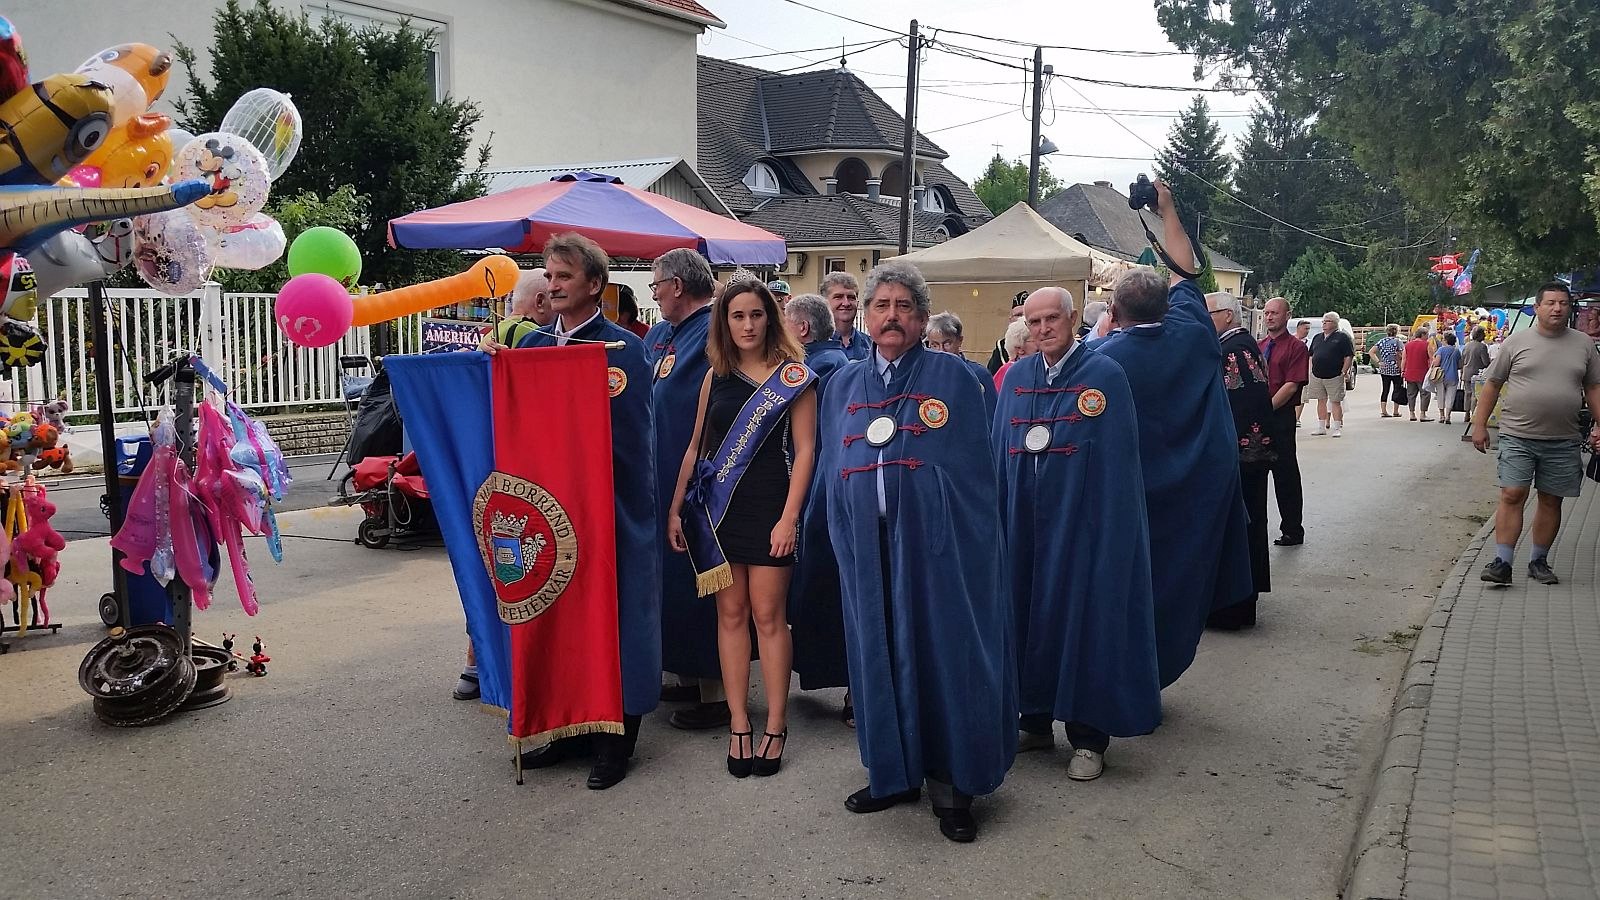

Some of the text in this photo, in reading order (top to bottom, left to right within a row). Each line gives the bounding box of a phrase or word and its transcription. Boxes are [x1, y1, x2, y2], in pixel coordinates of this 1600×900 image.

[762, 388, 787, 405] 2017
[502, 478, 570, 539] BORREND
[500, 569, 571, 620] FEHÉRVÁR
